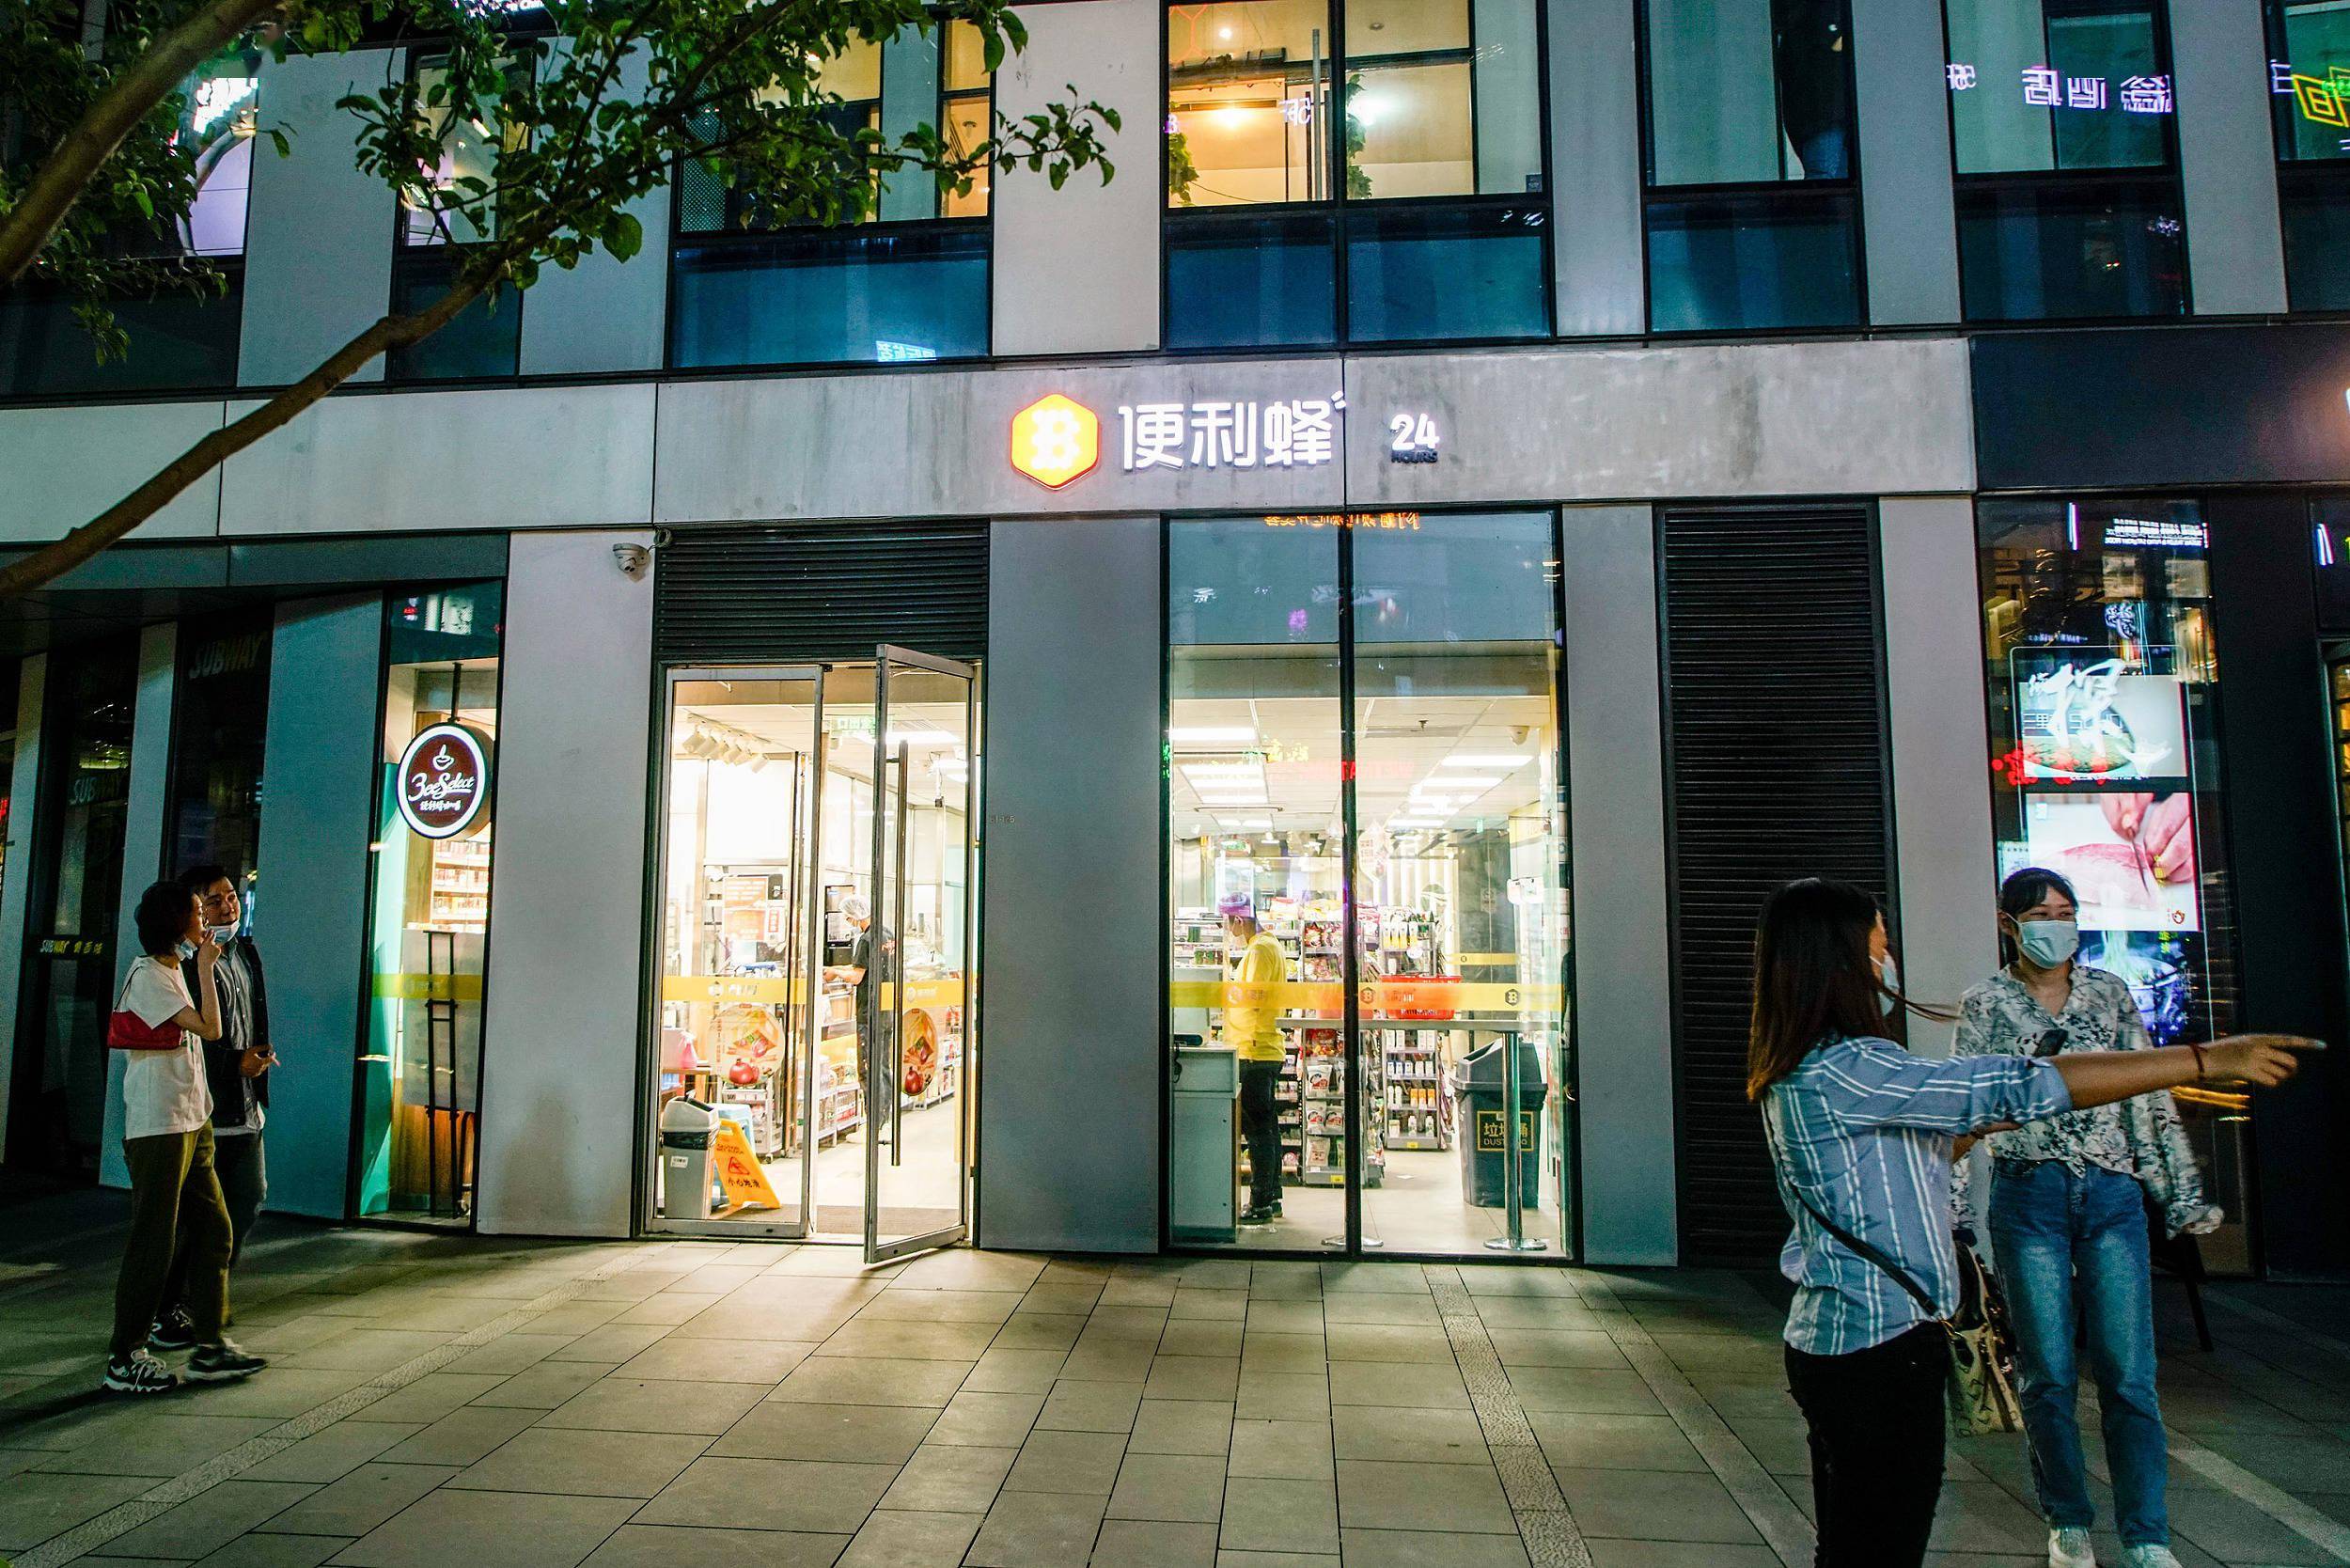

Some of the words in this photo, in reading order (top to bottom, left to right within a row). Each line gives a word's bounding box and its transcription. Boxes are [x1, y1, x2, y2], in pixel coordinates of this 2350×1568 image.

[1118, 395, 1344, 471] 便利蜂
[1390, 414, 1440, 450] 24
[1390, 450, 1439, 464] HOURS
[188, 632, 267, 680] SUBWAY
